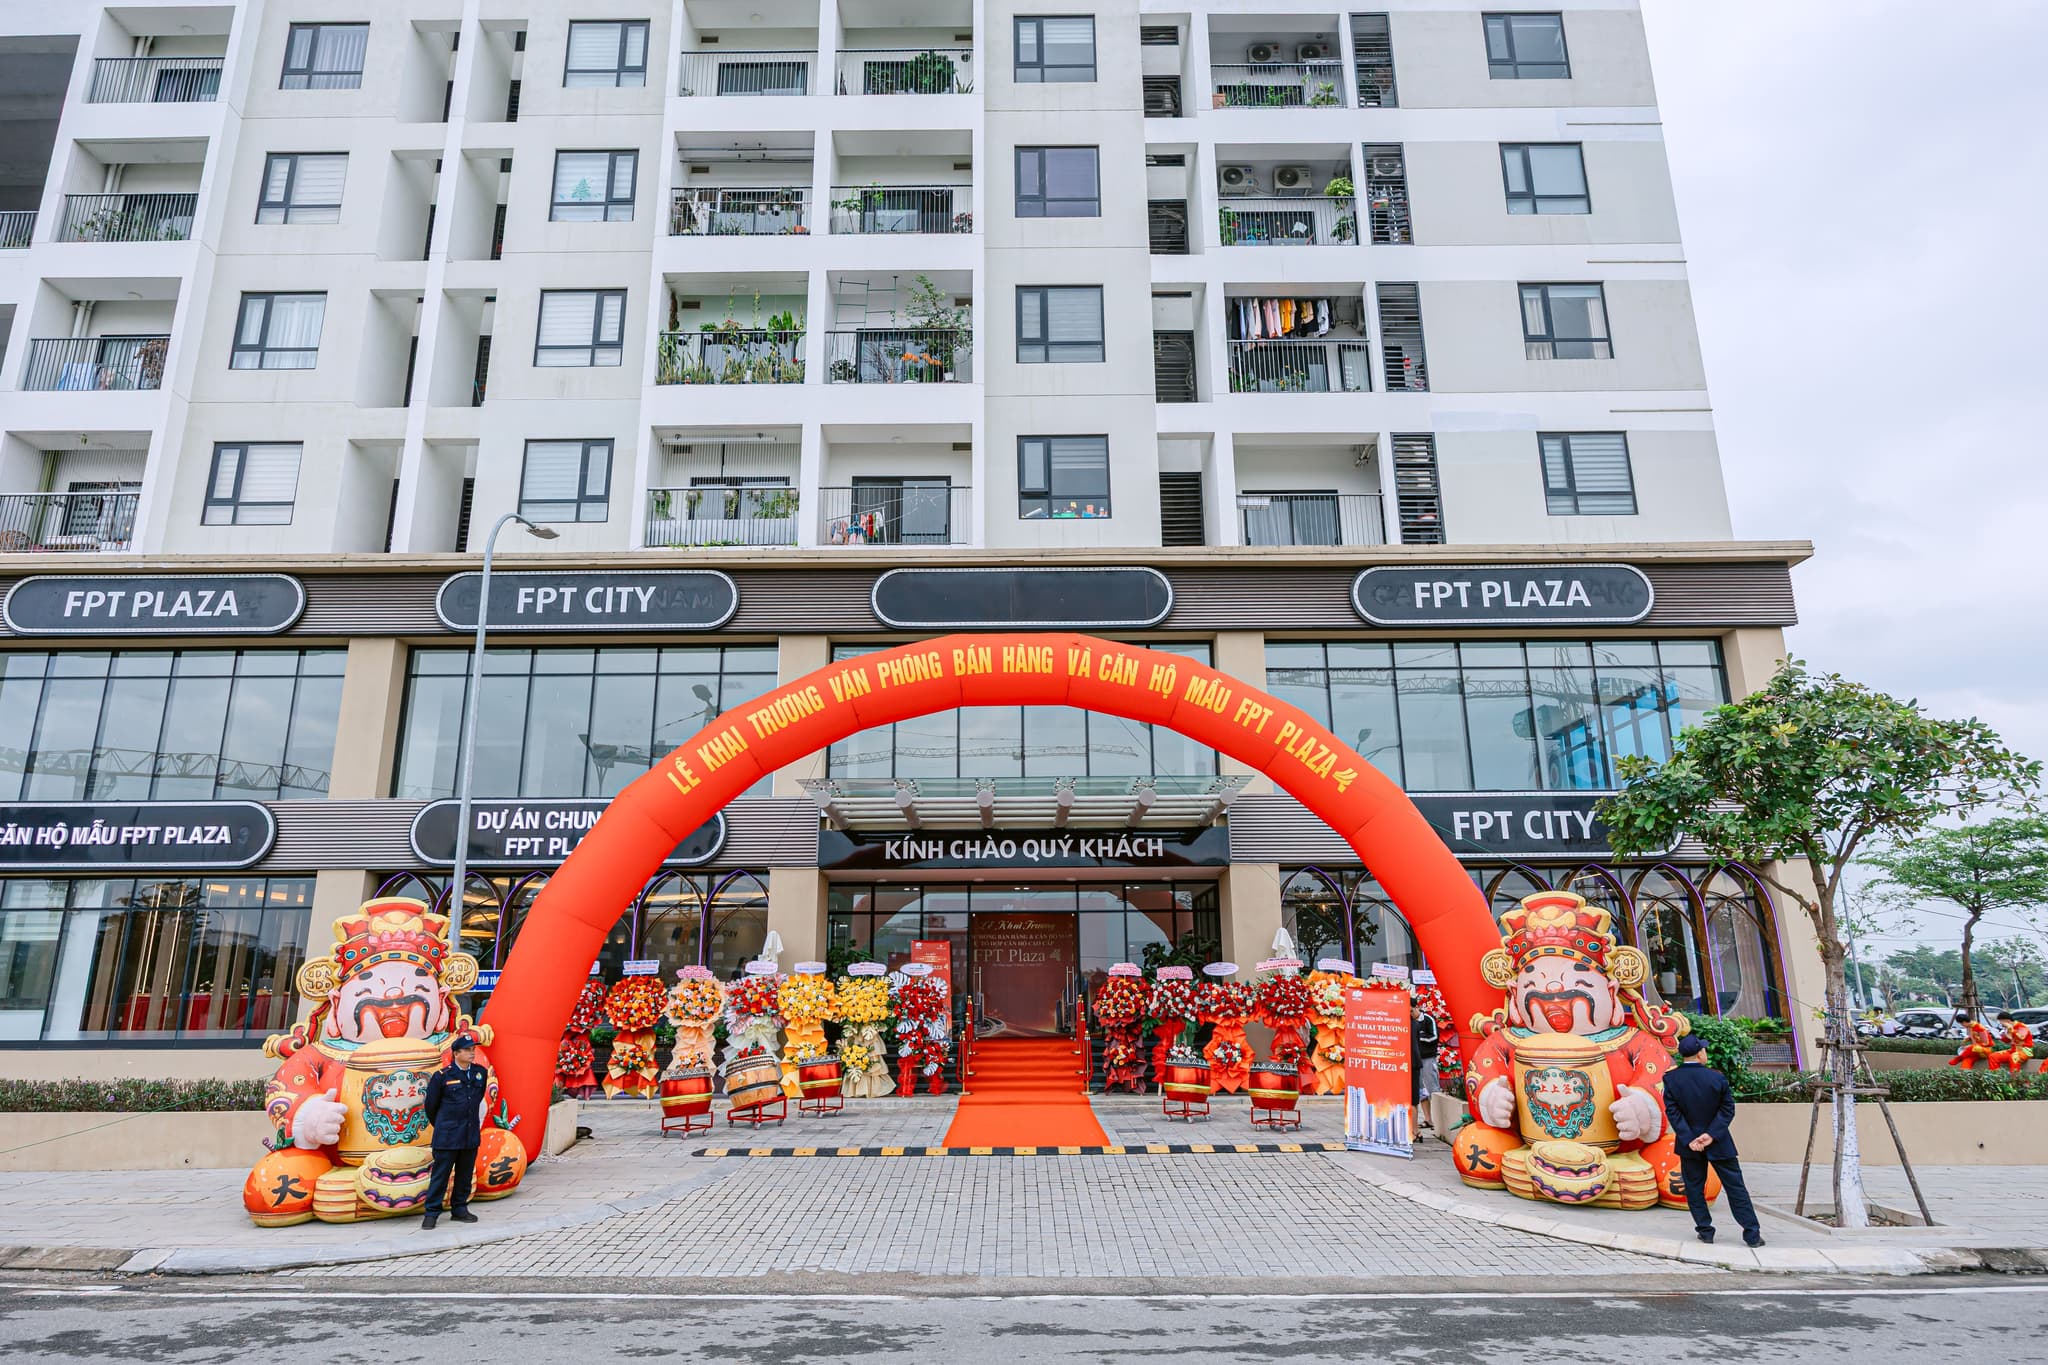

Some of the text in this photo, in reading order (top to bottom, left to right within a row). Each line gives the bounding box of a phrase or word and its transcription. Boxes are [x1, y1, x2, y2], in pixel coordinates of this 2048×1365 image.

[64, 590, 239, 617] FPT PLAZA
[516, 586, 657, 614] FPT CITY
[1414, 582, 1471, 608] FPT
[1481, 580, 1592, 608] PLAZA
[667, 756, 702, 795] LỄ
[696, 725, 749, 773] KHAI
[747, 686, 825, 740] TRƯƠNG
[828, 668, 872, 703] VĂN
[877, 651, 943, 689] PHÒNG
[953, 644, 992, 676] BÁN
[1003, 643, 1053, 674] HÀNG
[1067, 647, 1092, 679] VÀ
[1098, 653, 1140, 686] CĂN
[1147, 663, 1177, 700] HỘ
[1184, 675, 1232, 714] MẪU
[1233, 697, 1274, 734] FPT
[1274, 720, 1338, 779] PLAZA
[35, 821, 69, 849] HỘ
[70, 819, 117, 845] MẪU
[120, 826, 162, 845] FPT
[163, 826, 231, 845] PLAZA
[477, 808, 508, 834] DỰ
[510, 807, 540, 829] ÁN
[1453, 810, 1596, 840] FPT CITY
[505, 837, 585, 856] FPT PL
[885, 834, 1164, 862] KÍNH CHÀO QUÝ KHÁCH
[973, 948, 1004, 962] FPT
[1009, 948, 1046, 963] Plaza
[1348, 1056, 1369, 1069] FPT
[1371, 1059, 1398, 1072] Plaza
[488, 1156, 519, 1186] 吉
[1466, 1144, 1496, 1171] 大
[271, 1175, 308, 1207] 大
